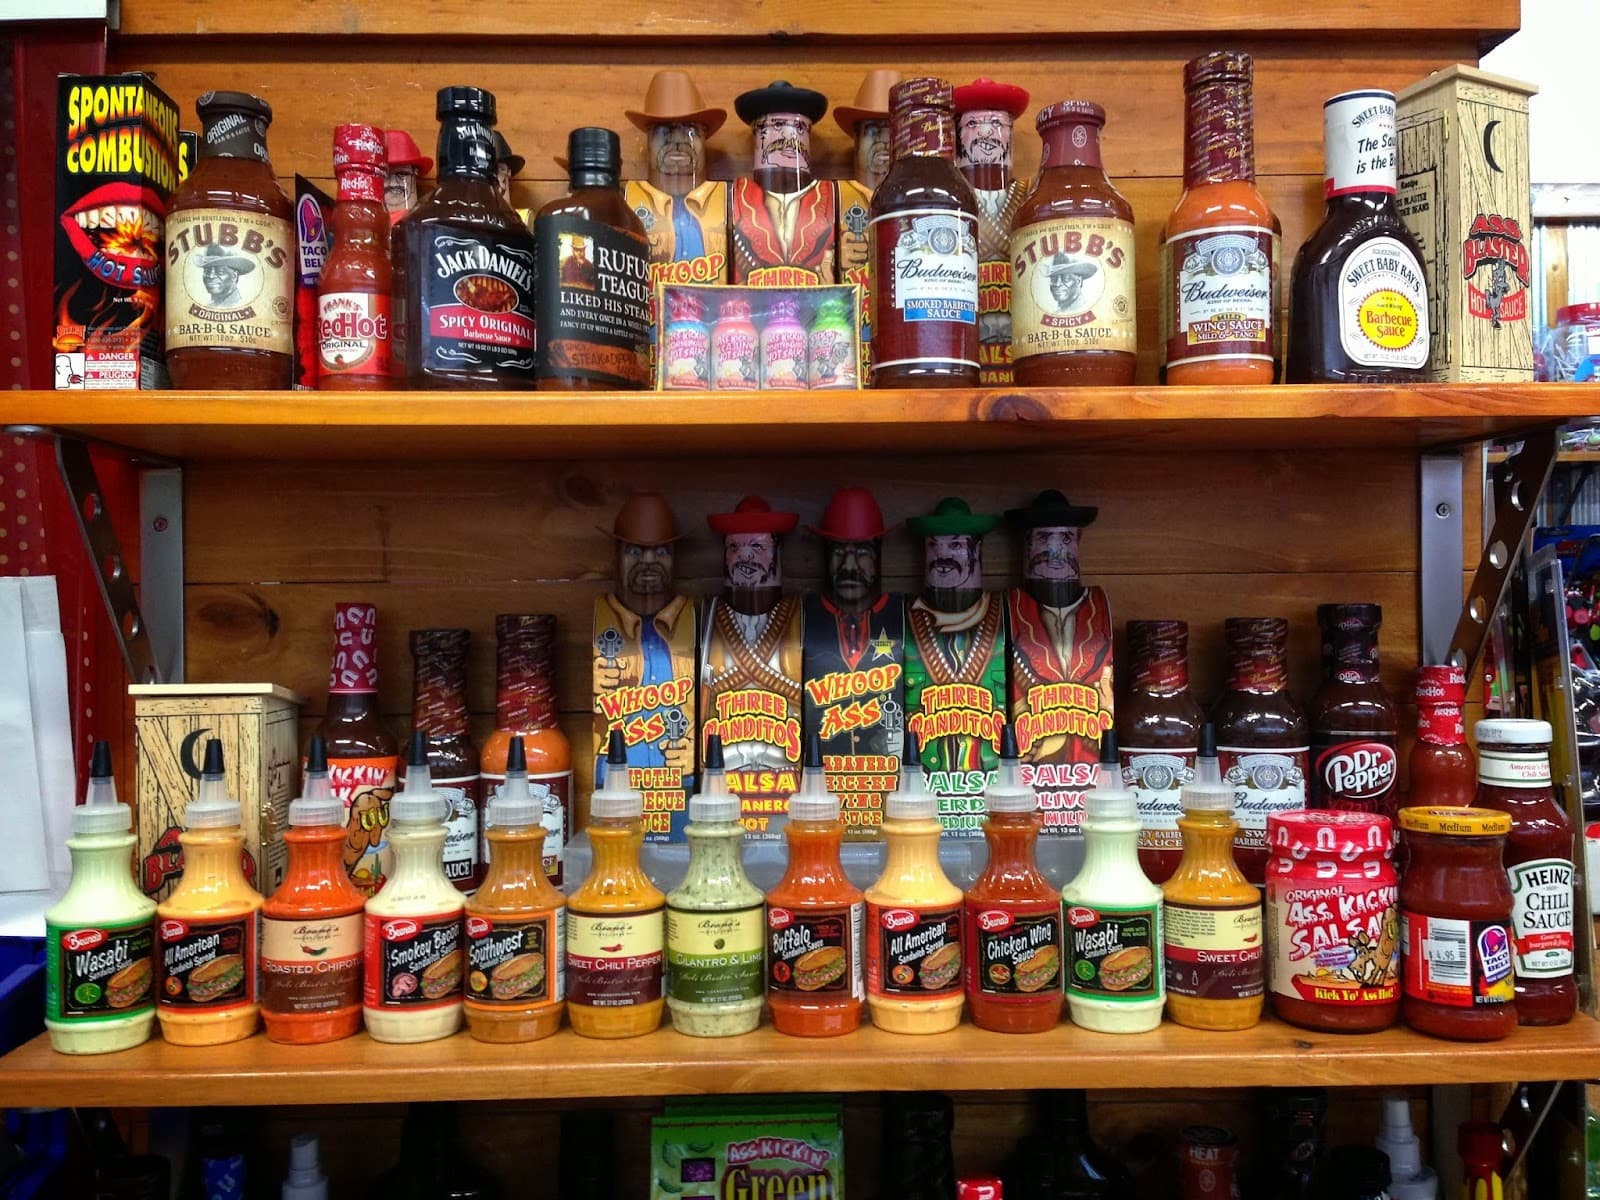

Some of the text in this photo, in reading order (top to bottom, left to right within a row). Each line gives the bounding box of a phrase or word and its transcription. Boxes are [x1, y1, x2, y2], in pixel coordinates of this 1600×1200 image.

[67, 86, 179, 158] SPONTANEOUS
[1351, 105, 1378, 128] SWEET
[206, 112, 247, 144] ORIGINAL
[1357, 137, 1378, 154] The
[66, 127, 176, 192] COMBUSTION
[1356, 160, 1367, 174] is
[1371, 155, 1387, 170] the
[1471, 214, 1522, 241] ASS
[168, 222, 287, 269] STUBB'S
[302, 247, 327, 255] TACO
[1015, 231, 1124, 278] STUBB'S
[88, 251, 125, 281] HOT
[435, 245, 534, 294] JACK DANIEL'S
[597, 247, 650, 281] RUFUS
[896, 257, 977, 282] Budweiser
[1346, 257, 1421, 293] SWEET BABY RAY'S
[560, 291, 601, 308] LIKED
[604, 298, 623, 313] HIS
[1181, 280, 1268, 303] Budweiser
[198, 310, 245, 321] ORIGINAL
[324, 298, 363, 314] FRANK'S
[560, 308, 576, 317] AND
[577, 310, 598, 321] EVERY
[600, 313, 616, 324] ONCE
[906, 299, 942, 310] SMOKED
[943, 300, 975, 312] BARBECUE
[927, 309, 961, 319] SAUCE
[1471, 296, 1523, 318] HOT SAUCE
[440, 315, 533, 340] SPICY ORIGINAL
[560, 320, 579, 329] FANCY
[580, 322, 586, 330] IT
[587, 323, 594, 331] UP
[595, 325, 609, 334] WITH
[1051, 318, 1082, 327] SPICY
[1192, 321, 1263, 333] WING SAUCE
[1366, 310, 1413, 327] Barbecue
[180, 324, 272, 338] BAR-B-Q SAUCE
[463, 328, 512, 343] Barbecue Sauce
[1028, 327, 1112, 343] BAR-B-Q SAUCE
[1376, 325, 1405, 338] Sauce
[99, 352, 135, 360] DANGER
[321, 341, 366, 350] ORIGINAL
[99, 371, 134, 379] PELIGRO
[805, 664, 902, 706] WHOOP
[598, 677, 694, 721] WHOOP
[717, 690, 788, 721] THREE
[921, 683, 994, 715] THREE
[1028, 683, 1099, 714] THREE
[819, 698, 883, 740] ASS
[1353, 750, 1382, 773] Dr
[628, 767, 682, 788] IPOTLE
[1326, 755, 1394, 793] Pepper
[1234, 791, 1303, 809] Budweiser
[1405, 819, 1506, 832] Medium Medium Medium
[1525, 868, 1570, 888] HEINZ
[1287, 886, 1346, 902] ORIGINAL
[1526, 892, 1569, 911] CHILI
[1289, 902, 1334, 924] ASS
[1523, 910, 1572, 929] SAUCE
[391, 924, 461, 967] Smokey Bacon
[469, 931, 524, 965] Southwest
[773, 925, 811, 953] Buffalo
[890, 922, 946, 955] All American
[987, 923, 1052, 960] Chicken Wing
[1075, 923, 1119, 952] Wasabi
[1290, 915, 1381, 960] SALSA
[76, 940, 129, 977] Wasabi
[164, 934, 220, 967] All American
[676, 953, 728, 968] CILANTRO
[730, 955, 739, 964] &
[782, 939, 825, 961] Sandwich Sauce
[898, 949, 926, 965] Sandwich
[1012, 949, 1035, 965] Sauce
[1084, 947, 1108, 960] Sandwich
[1197, 951, 1236, 962] SWEET
[1435, 949, 1456, 960] 4.95
[1485, 952, 1508, 965] TACO
[169, 950, 216, 976] Sandwich Spread
[265, 962, 313, 975] ROASTED
[409, 953, 440, 974] Sandwich
[479, 957, 500, 970] Sandwich
[568, 956, 661, 970] SWEET CHILI PEPPER
[1488, 960, 1508, 972] BELL
[88, 966, 116, 982] Sandwich
[1315, 988, 1378, 1001] Kick Yo' Ass
[730, 1140, 828, 1166] ASS KICKIN'
[725, 1168, 828, 1200] Green
